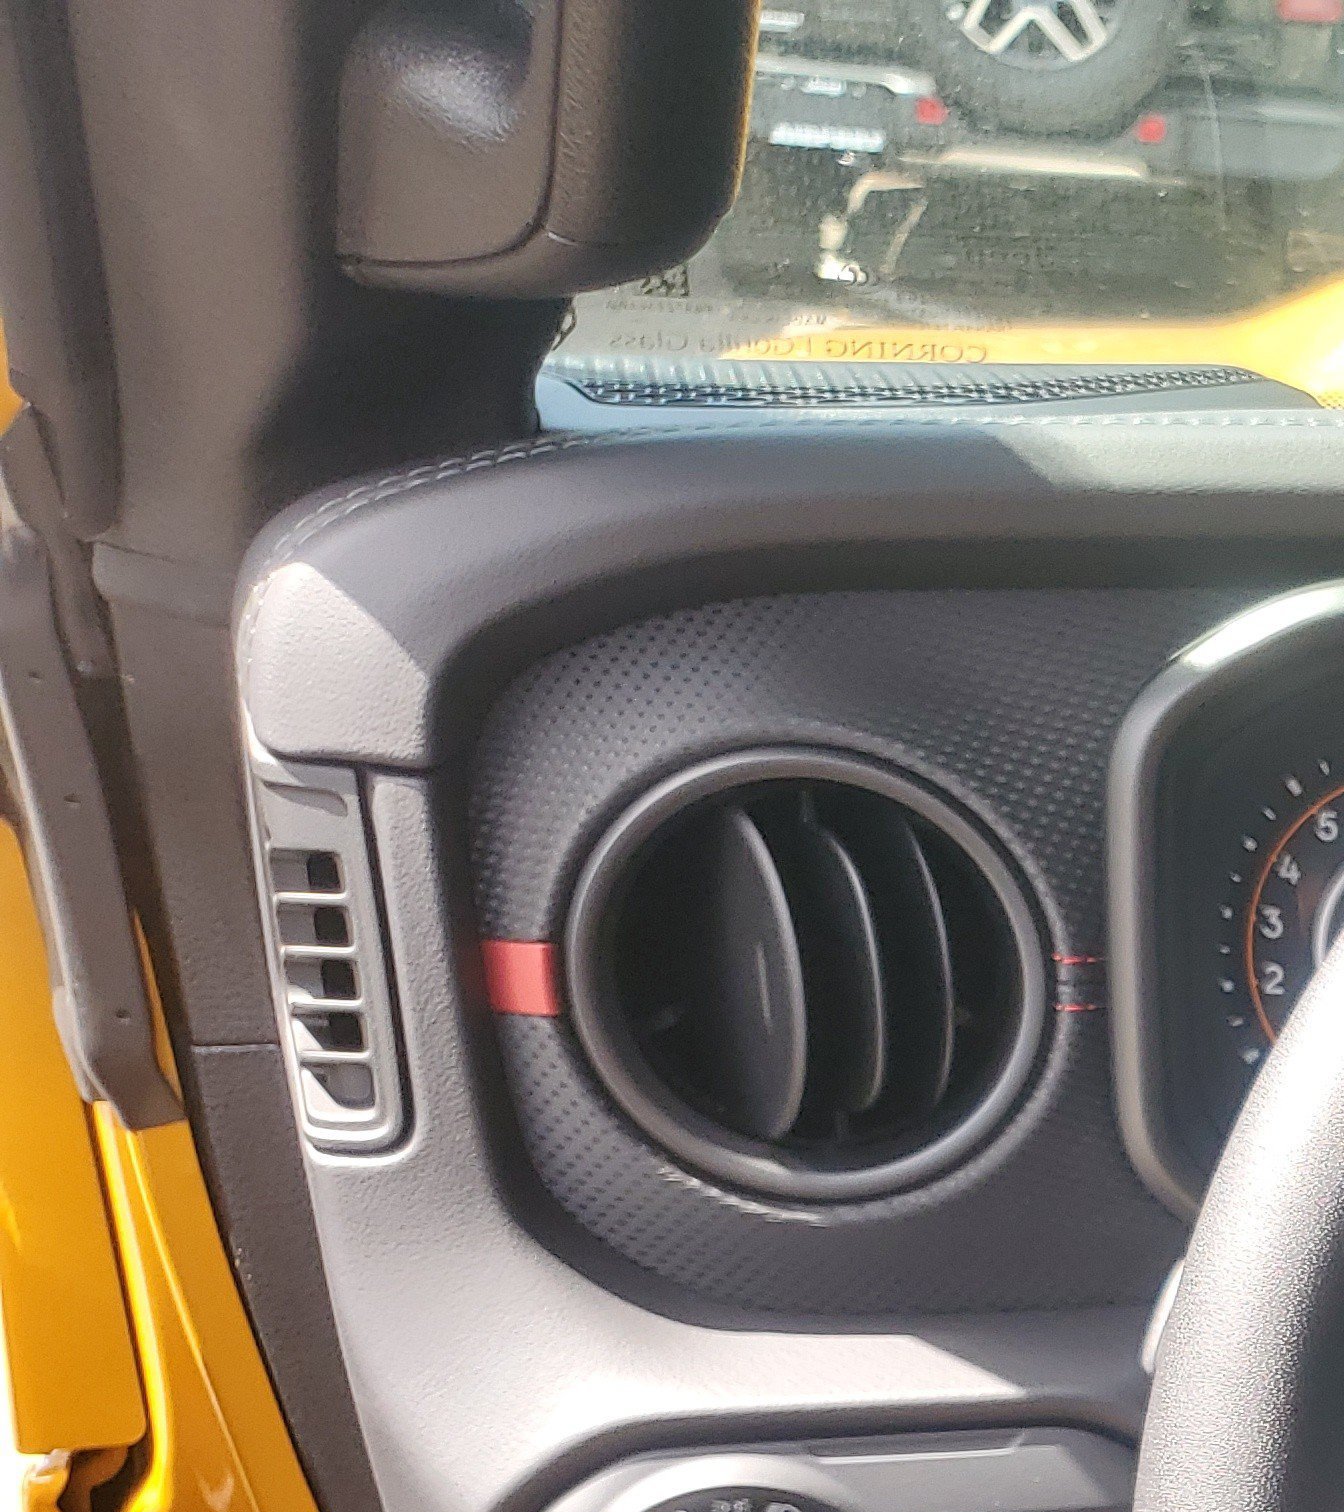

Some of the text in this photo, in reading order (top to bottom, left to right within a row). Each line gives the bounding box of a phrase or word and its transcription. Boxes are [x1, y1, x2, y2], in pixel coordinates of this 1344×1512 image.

[1315, 810, 1339, 842] 5
[1277, 853, 1302, 886] 4
[1260, 904, 1284, 940] 3
[1262, 961, 1285, 996] 2
